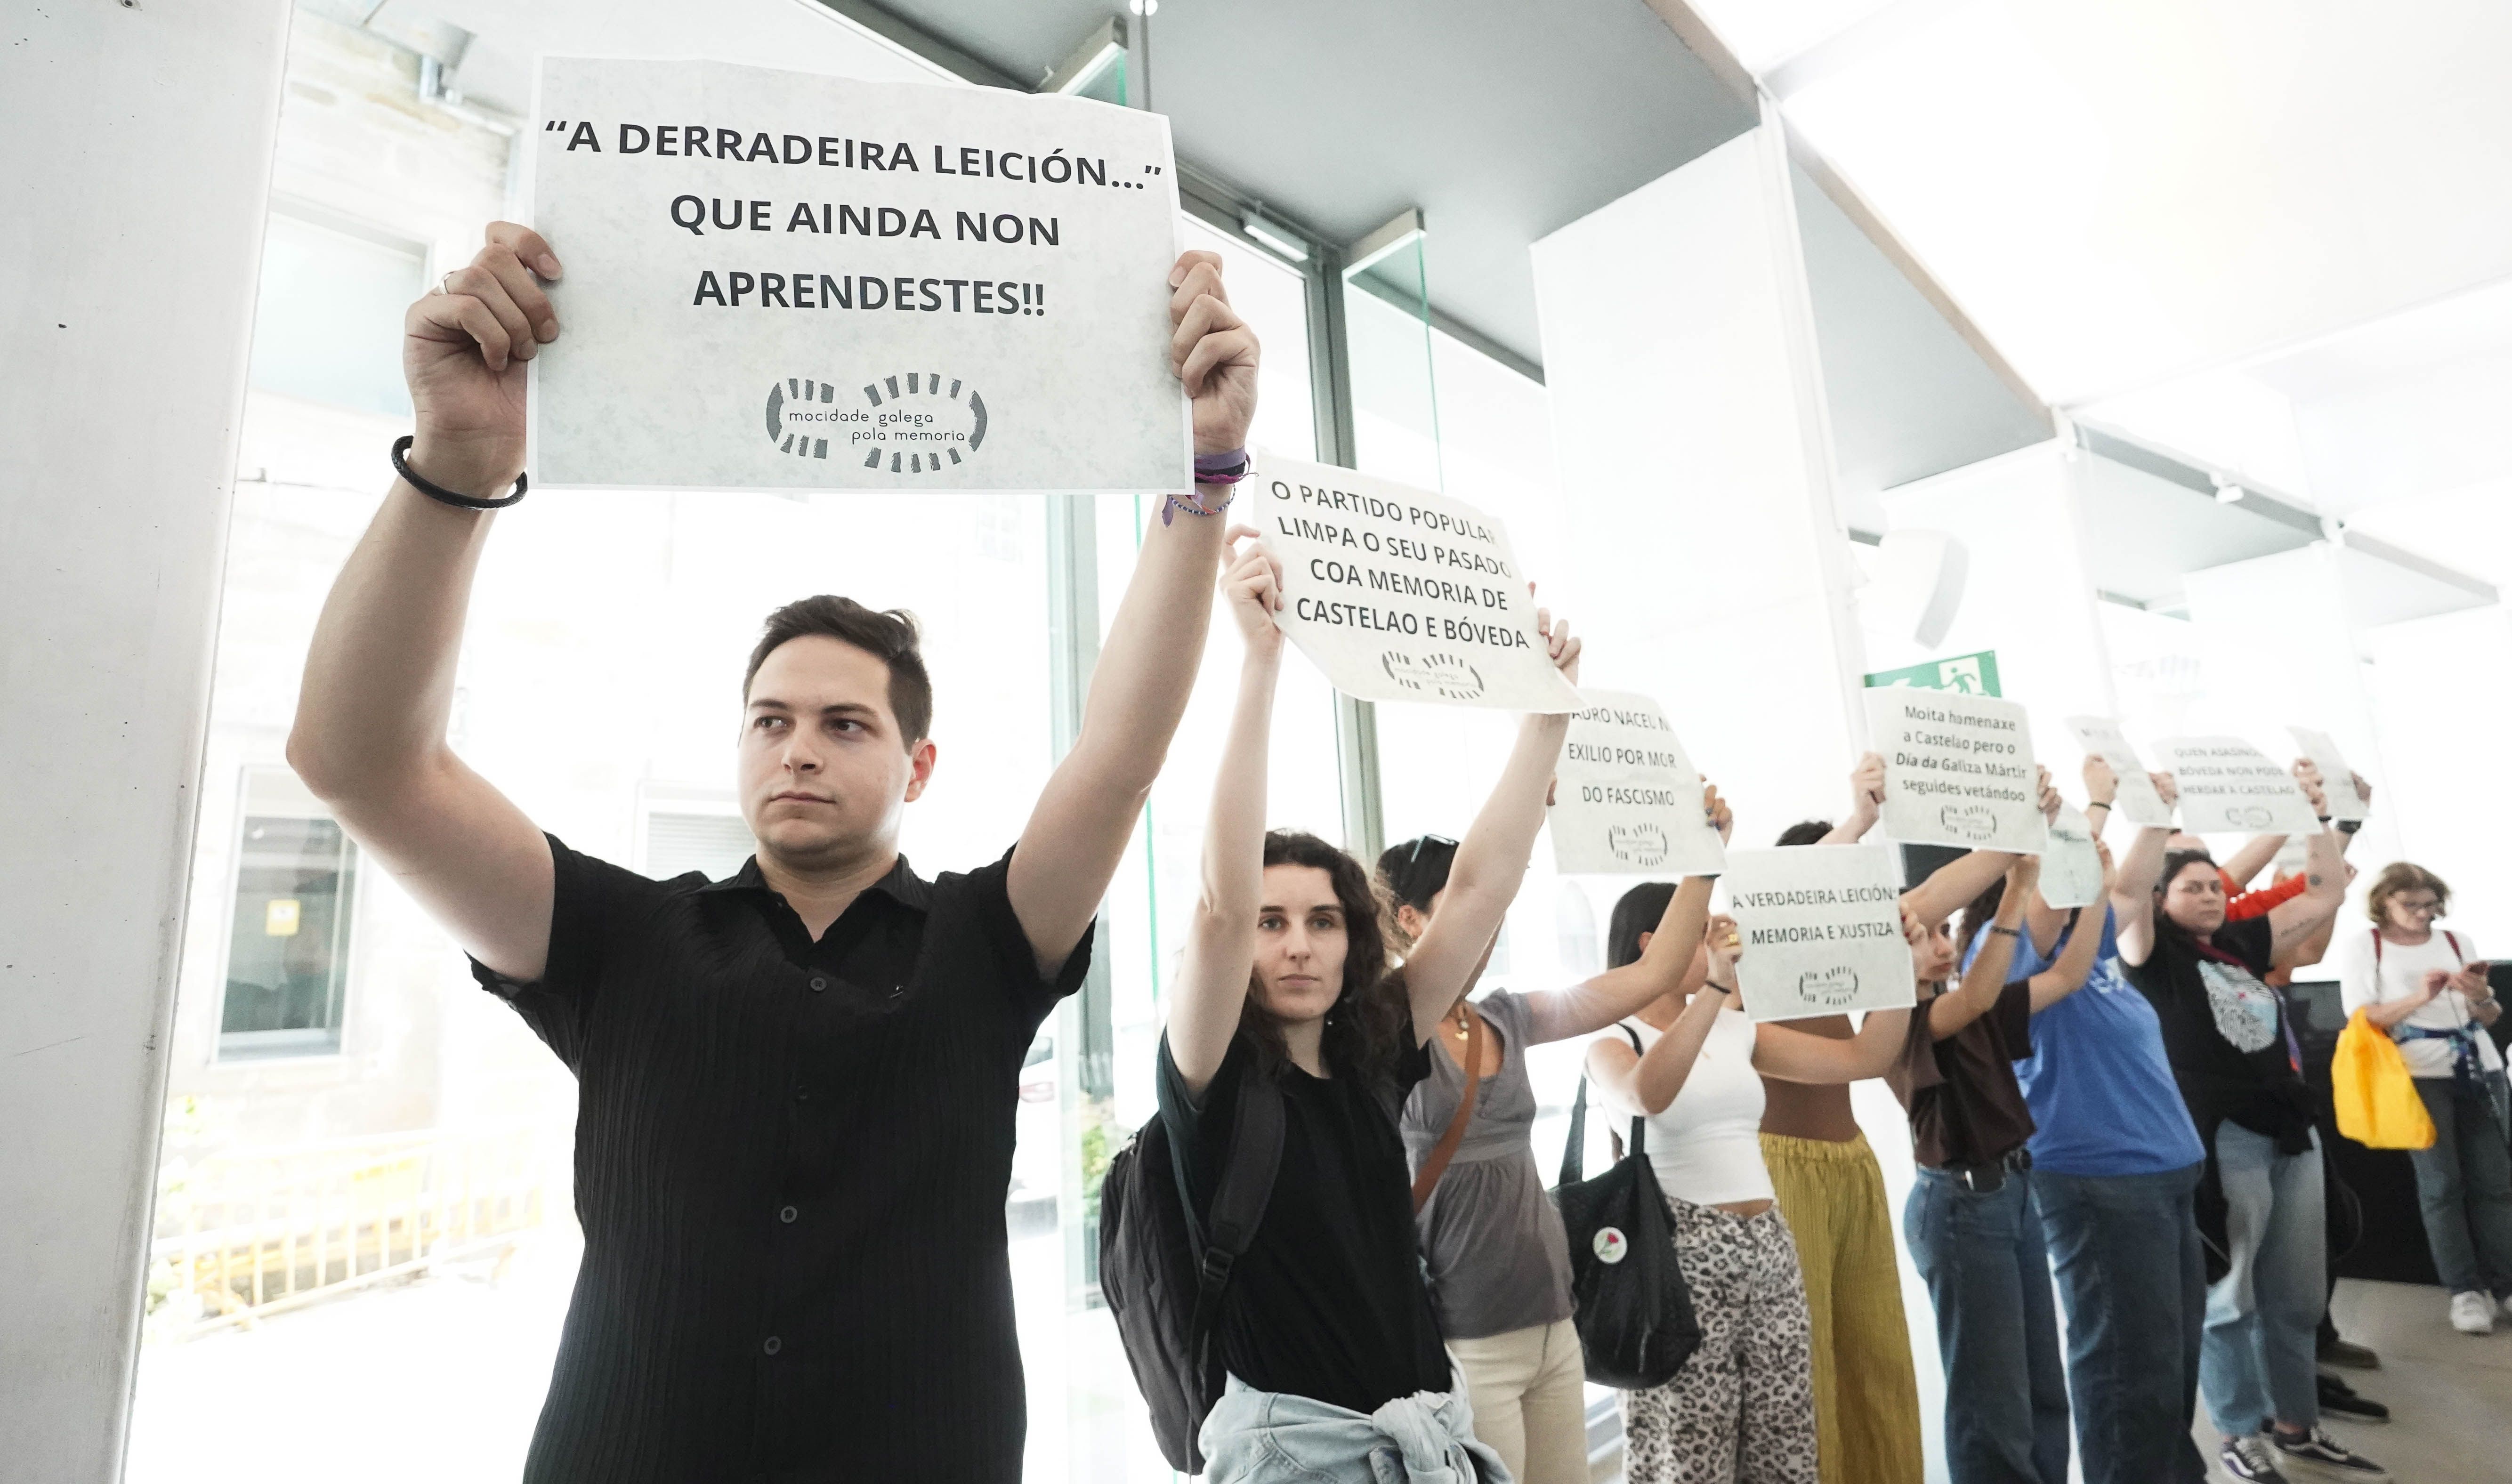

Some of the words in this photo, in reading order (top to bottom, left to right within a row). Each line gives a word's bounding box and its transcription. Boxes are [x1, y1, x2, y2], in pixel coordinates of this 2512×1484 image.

[619, 123, 920, 172] DERRADEIRA
[670, 194, 771, 235] QUE
[786, 202, 941, 240] AINDA
[956, 211, 1059, 246] NON
[693, 270, 1044, 316] APRENDESTES!!
[789, 408, 869, 422] mocidade
[879, 409, 933, 427] galega
[852, 422, 888, 445] pola
[895, 426, 965, 441] memoria
[1271, 481, 1291, 500] O
[1299, 484, 1402, 521] PARTIDO
[1277, 516, 1358, 548] LIMPA
[1363, 532, 1380, 552] O
[1386, 537, 1427, 561] SEU
[1434, 546, 1511, 579] PASADO
[1310, 558, 1363, 587] COA
[1368, 566, 1478, 605] MEMORIA
[1482, 588, 1508, 611] DE
[1297, 597, 1418, 635] CASTELAO
[1426, 616, 1437, 637] E
[1444, 616, 1530, 648] BÓVEDA
[1905, 706, 1945, 723] Moita
[1949, 710, 2015, 731] homenaxe
[1568, 743, 1612, 763] EXILIO
[1616, 748, 1645, 765] POR
[1904, 732, 1911, 742] a
[1915, 731, 1970, 750] Castelao
[1973, 741, 2004, 754] pero
[2007, 744, 2016, 755] o
[2174, 748, 2208, 758] QUEN
[1921, 756, 1938, 769] da
[1941, 758, 1982, 774] Galiza
[1985, 763, 2026, 778] Mártir
[1582, 786, 1603, 803] DO
[1607, 787, 1674, 806] FASCISMO
[1903, 779, 1962, 796] seguides
[1733, 895, 1743, 908] A
[1745, 889, 1837, 907] VERDADEIRA
[1752, 927, 1824, 944] MEMORIA
[1827, 926, 1835, 940] E
[1838, 922, 1894, 938] XUSTIZA
